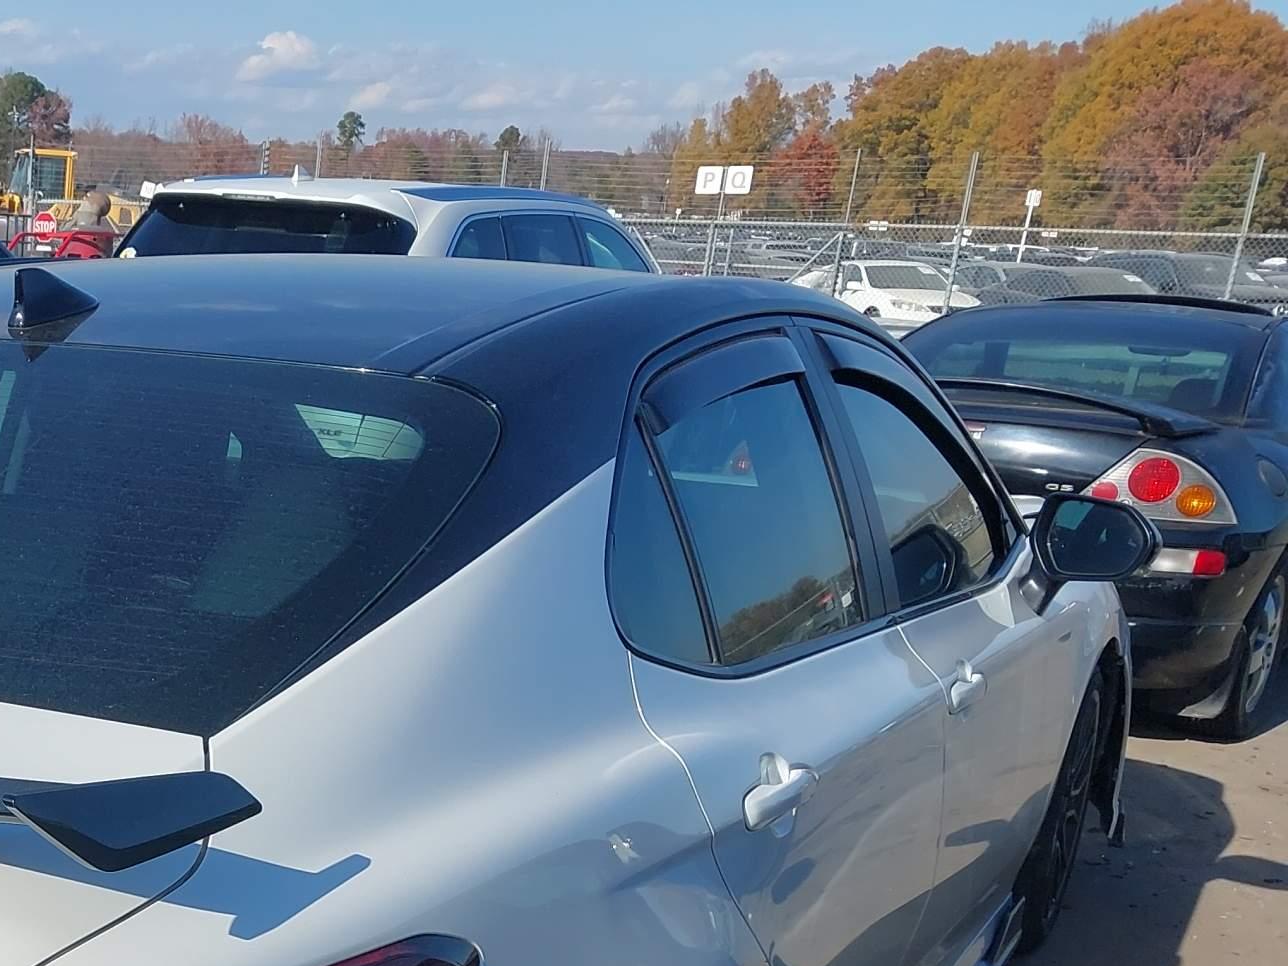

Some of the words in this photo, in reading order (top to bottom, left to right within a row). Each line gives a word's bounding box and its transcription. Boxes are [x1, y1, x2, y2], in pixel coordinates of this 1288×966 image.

[703, 172, 716, 189] P
[731, 171, 746, 189] Q
[35, 220, 56, 233] STOP
